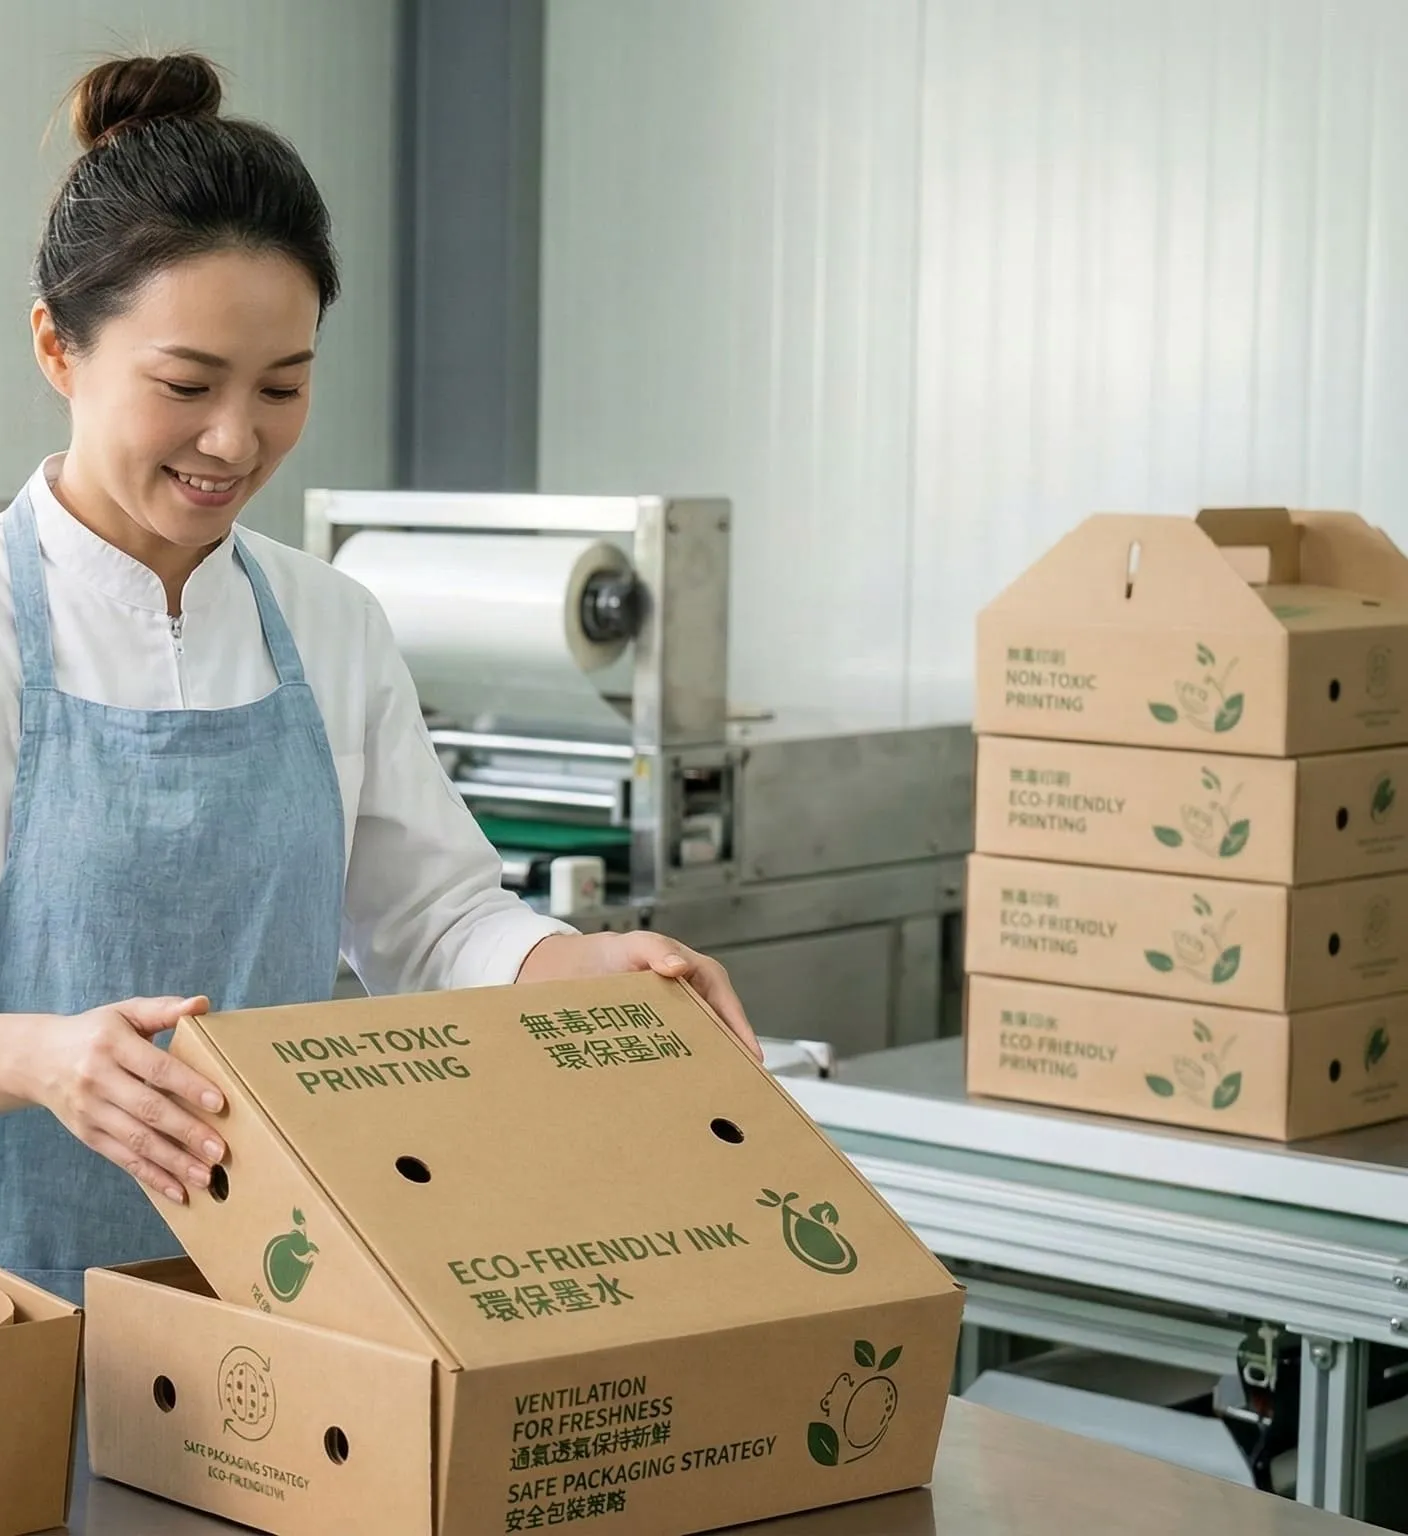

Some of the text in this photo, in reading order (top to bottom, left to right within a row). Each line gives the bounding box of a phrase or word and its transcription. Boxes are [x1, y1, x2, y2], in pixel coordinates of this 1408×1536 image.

[1006, 670, 1099, 691] NON-TOXIC
[1005, 691, 1084, 713] PRINTING
[1008, 811, 1087, 833] PRINTING
[1009, 790, 1126, 815] ECO-FRIENDLY
[1000, 909, 1118, 938] ECO-FRIENDLY
[1000, 931, 1078, 956] PRINTING
[519, 1001, 665, 1040] 無毒印刷
[271, 1024, 471, 1064] NON-TOXIC
[999, 1031, 1118, 1064] ECO-FRIENDLY
[295, 1056, 471, 1095] PRINTING
[999, 1052, 1078, 1079] PRINTING
[447, 1222, 750, 1285] ECO-FRIENDLY INK
[469, 1273, 635, 1322] 環保墨水
[514, 1375, 648, 1416] VENTILATION
[512, 1396, 673, 1443] FOR FRESHNESS
[508, 1420, 672, 1472] 通氣透氣保持新鮮
[507, 1435, 778, 1504] SAFE PACKAGING STRATEGY
[504, 1488, 627, 1533] 安全包裝策略
